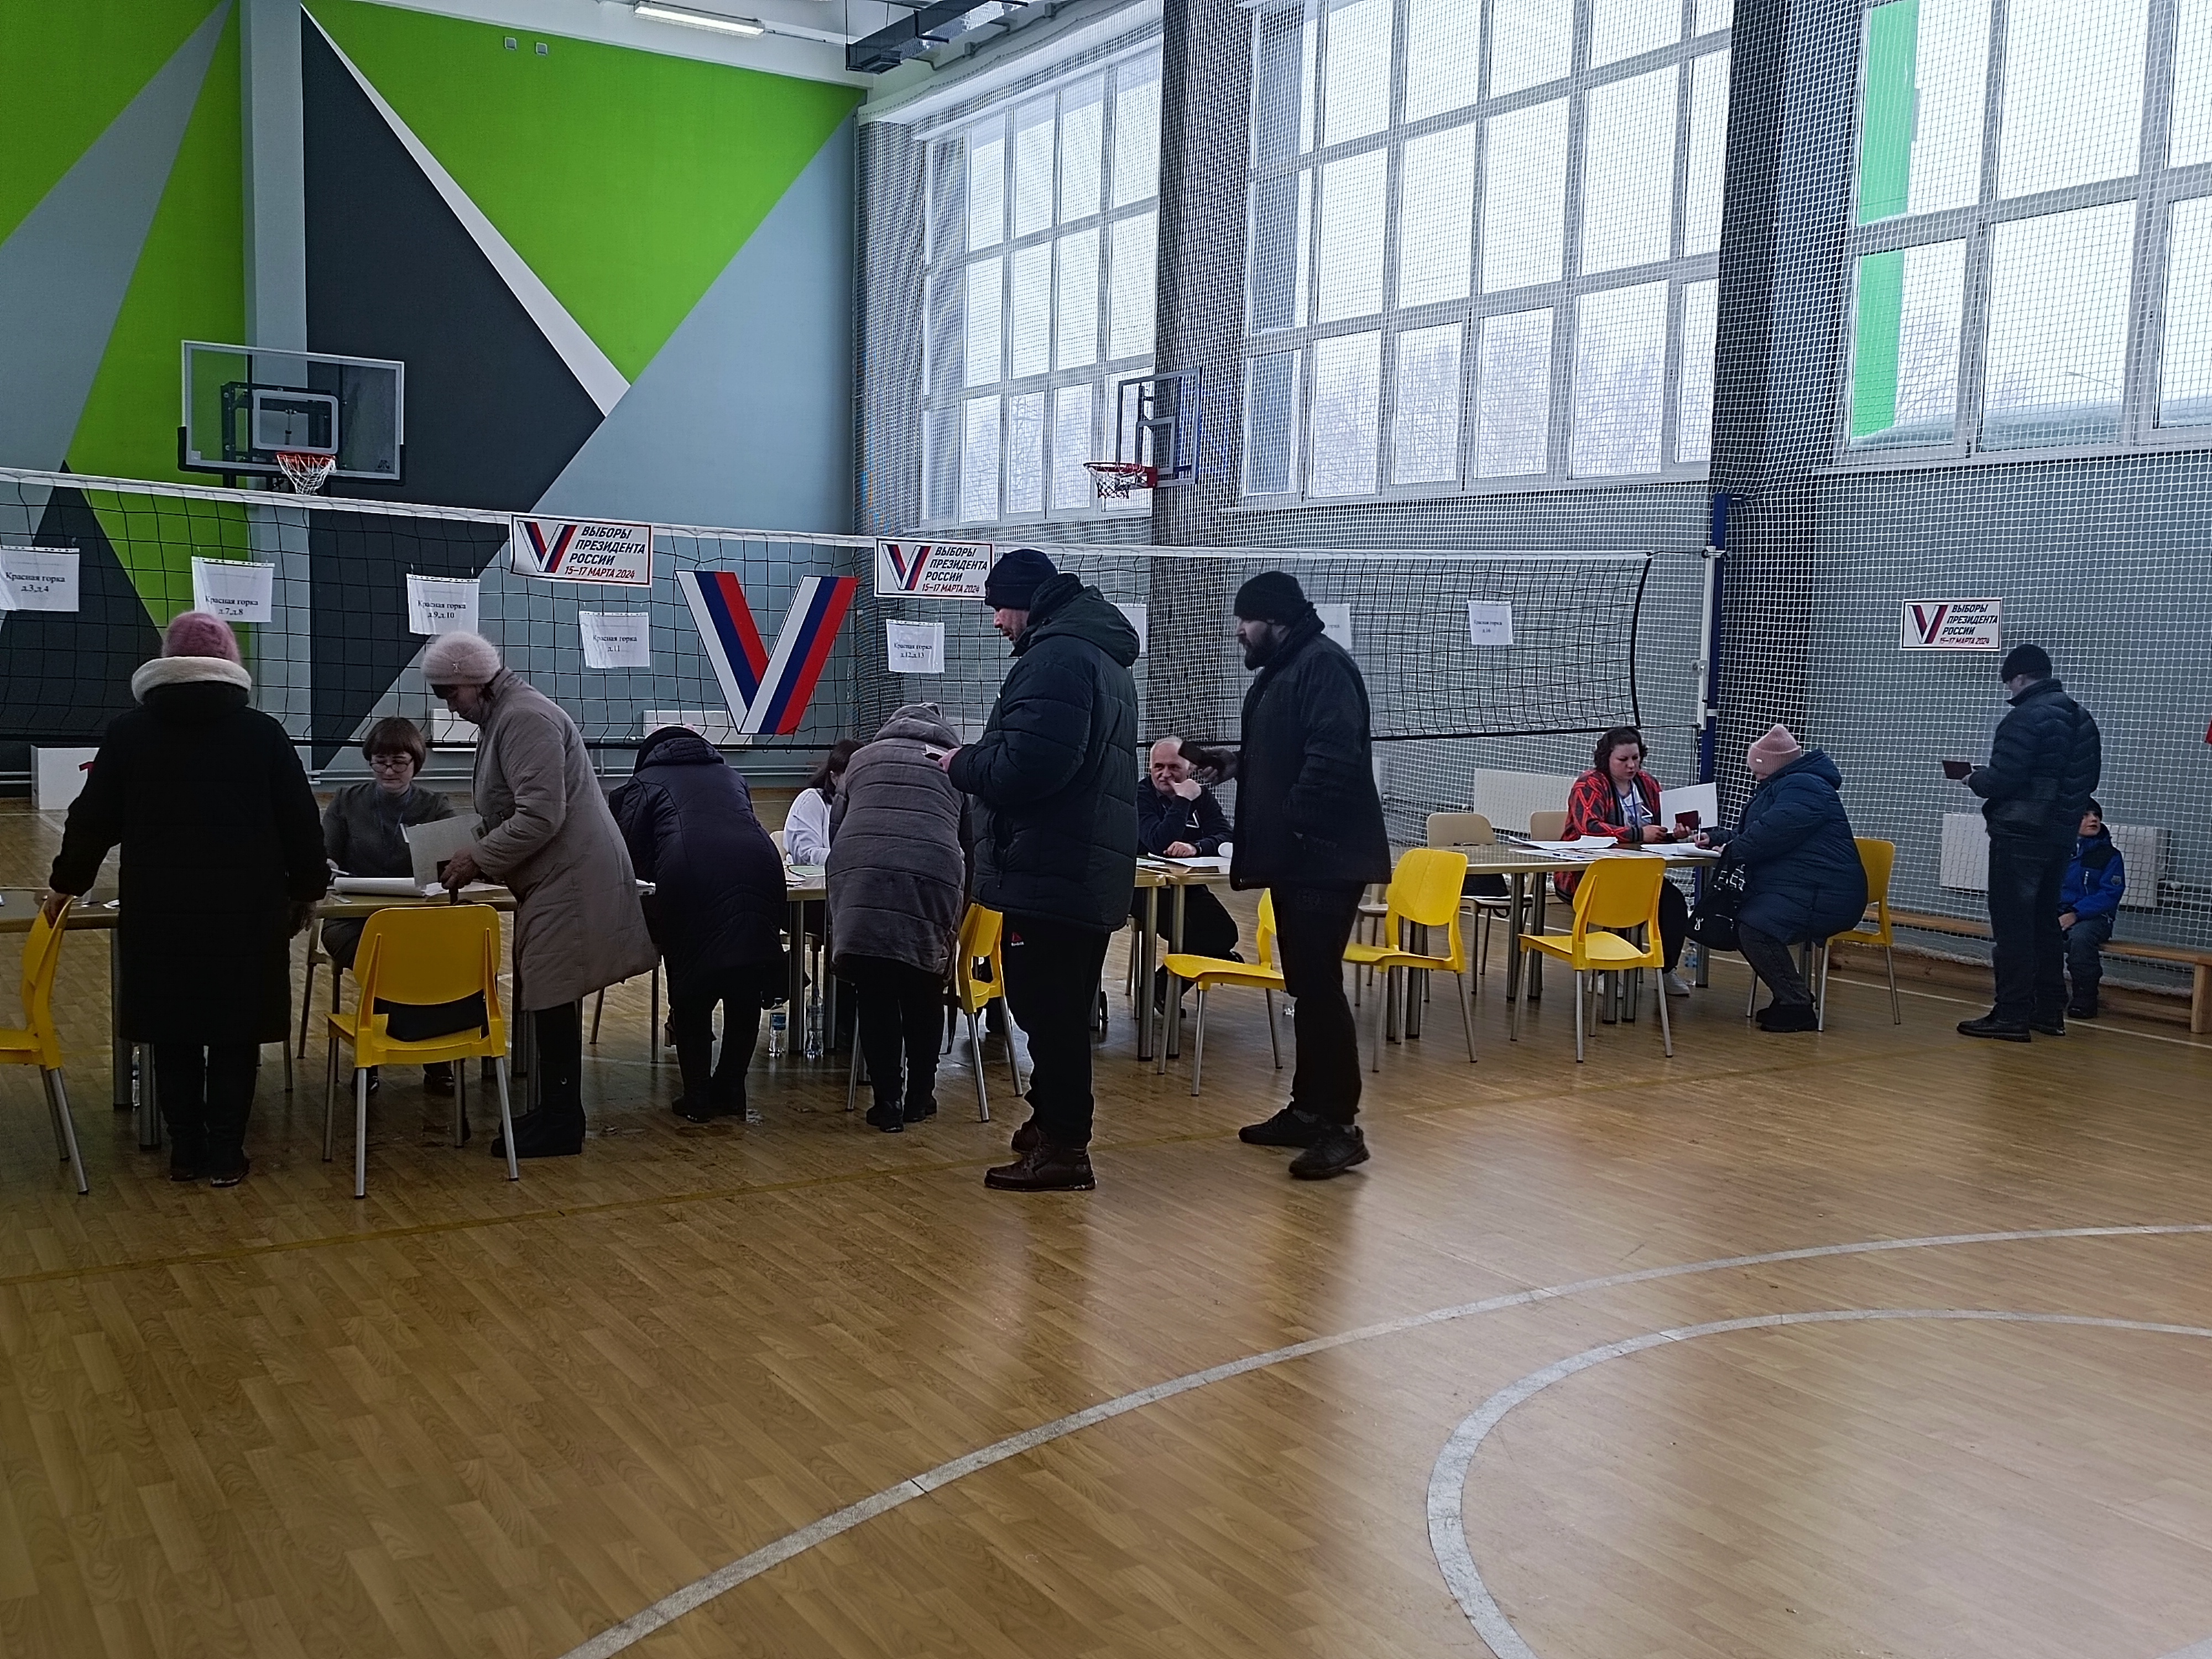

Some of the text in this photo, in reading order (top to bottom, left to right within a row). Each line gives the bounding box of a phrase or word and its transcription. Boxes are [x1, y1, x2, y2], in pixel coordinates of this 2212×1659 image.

[581, 526, 632, 539] ВЫБОРЫ
[575, 539, 646, 554] ПРЕЗИДЕНТА
[935, 546, 977, 557] ВЫБОРЫ
[569, 553, 615, 565] РОССИИ
[930, 559, 988, 571] ПРЕЗИДЕНТА
[587, 567, 615, 577] МАРТА
[615, 569, 635, 578] 2024
[925, 571, 963, 582] РОССИИ
[941, 584, 963, 592] МАРТА
[205, 596, 235, 604] Красная
[1952, 604, 1988, 613] ВЫБОРЫ
[1947, 615, 1998, 625] ПРЕЗИДЕНТА
